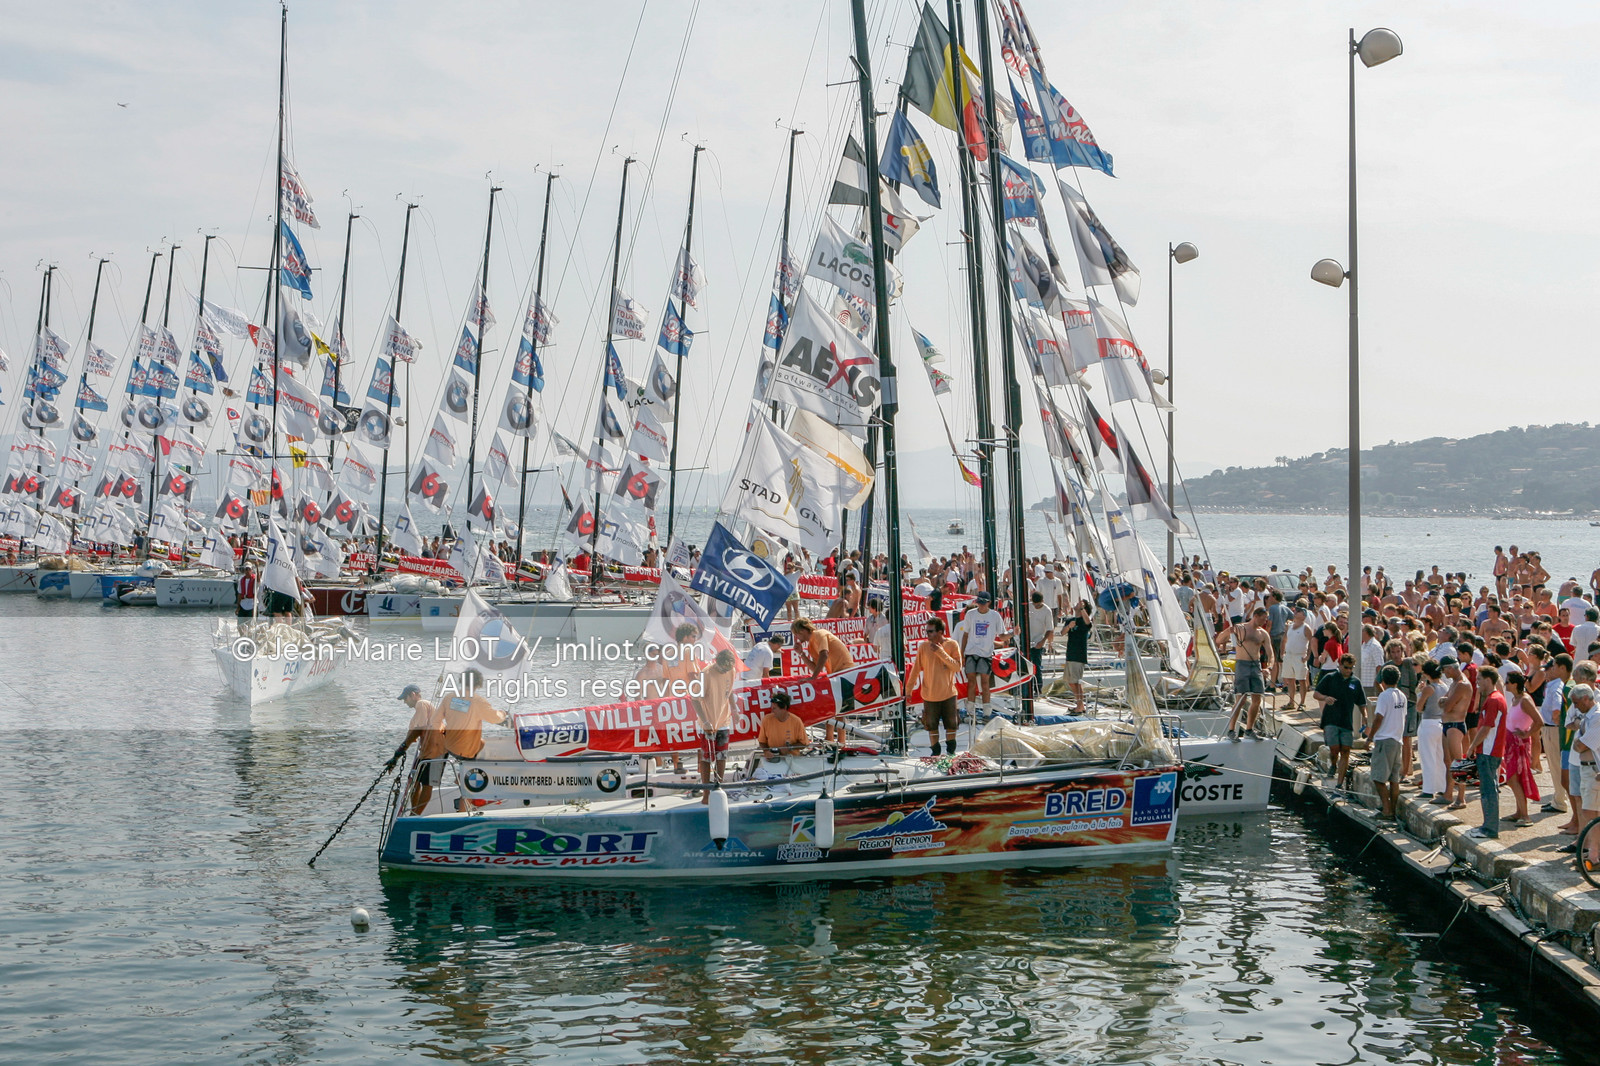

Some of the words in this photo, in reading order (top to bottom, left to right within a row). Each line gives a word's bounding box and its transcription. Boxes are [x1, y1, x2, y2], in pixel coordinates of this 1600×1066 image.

[817, 252, 876, 290] LACOS
[616, 318, 642, 331] FRANCE
[738, 478, 782, 504] STAD
[800, 507, 834, 538] GENT
[356, 553, 377, 562] ALPES
[698, 570, 769, 622] HYUNDAI
[837, 620, 863, 633] INTERIM
[590, 705, 653, 731] VILLE
[657, 699, 688, 723] DU
[552, 723, 584, 732] France
[634, 726, 661, 748] LA
[493, 776, 510, 786] VILLE
[510, 776, 519, 786] DU
[520, 776, 552, 786] PORT-BRED
[557, 776, 566, 786] LA
[566, 776, 593, 787] REUNION
[1180, 783, 1244, 801] COSTE
[1045, 788, 1126, 817] BRED
[1134, 808, 1171, 816] BANQUE
[1134, 814, 1171, 823] POPULAIRE
[1009, 827, 1039, 837] Banque
[1041, 825, 1050, 833] et
[1051, 821, 1088, 835] populaire
[1098, 819, 1106, 828] la
[1107, 818, 1122, 828] fois
[415, 833, 479, 852] LE
[858, 839, 891, 850] REGION
[894, 835, 932, 847] REUNION
